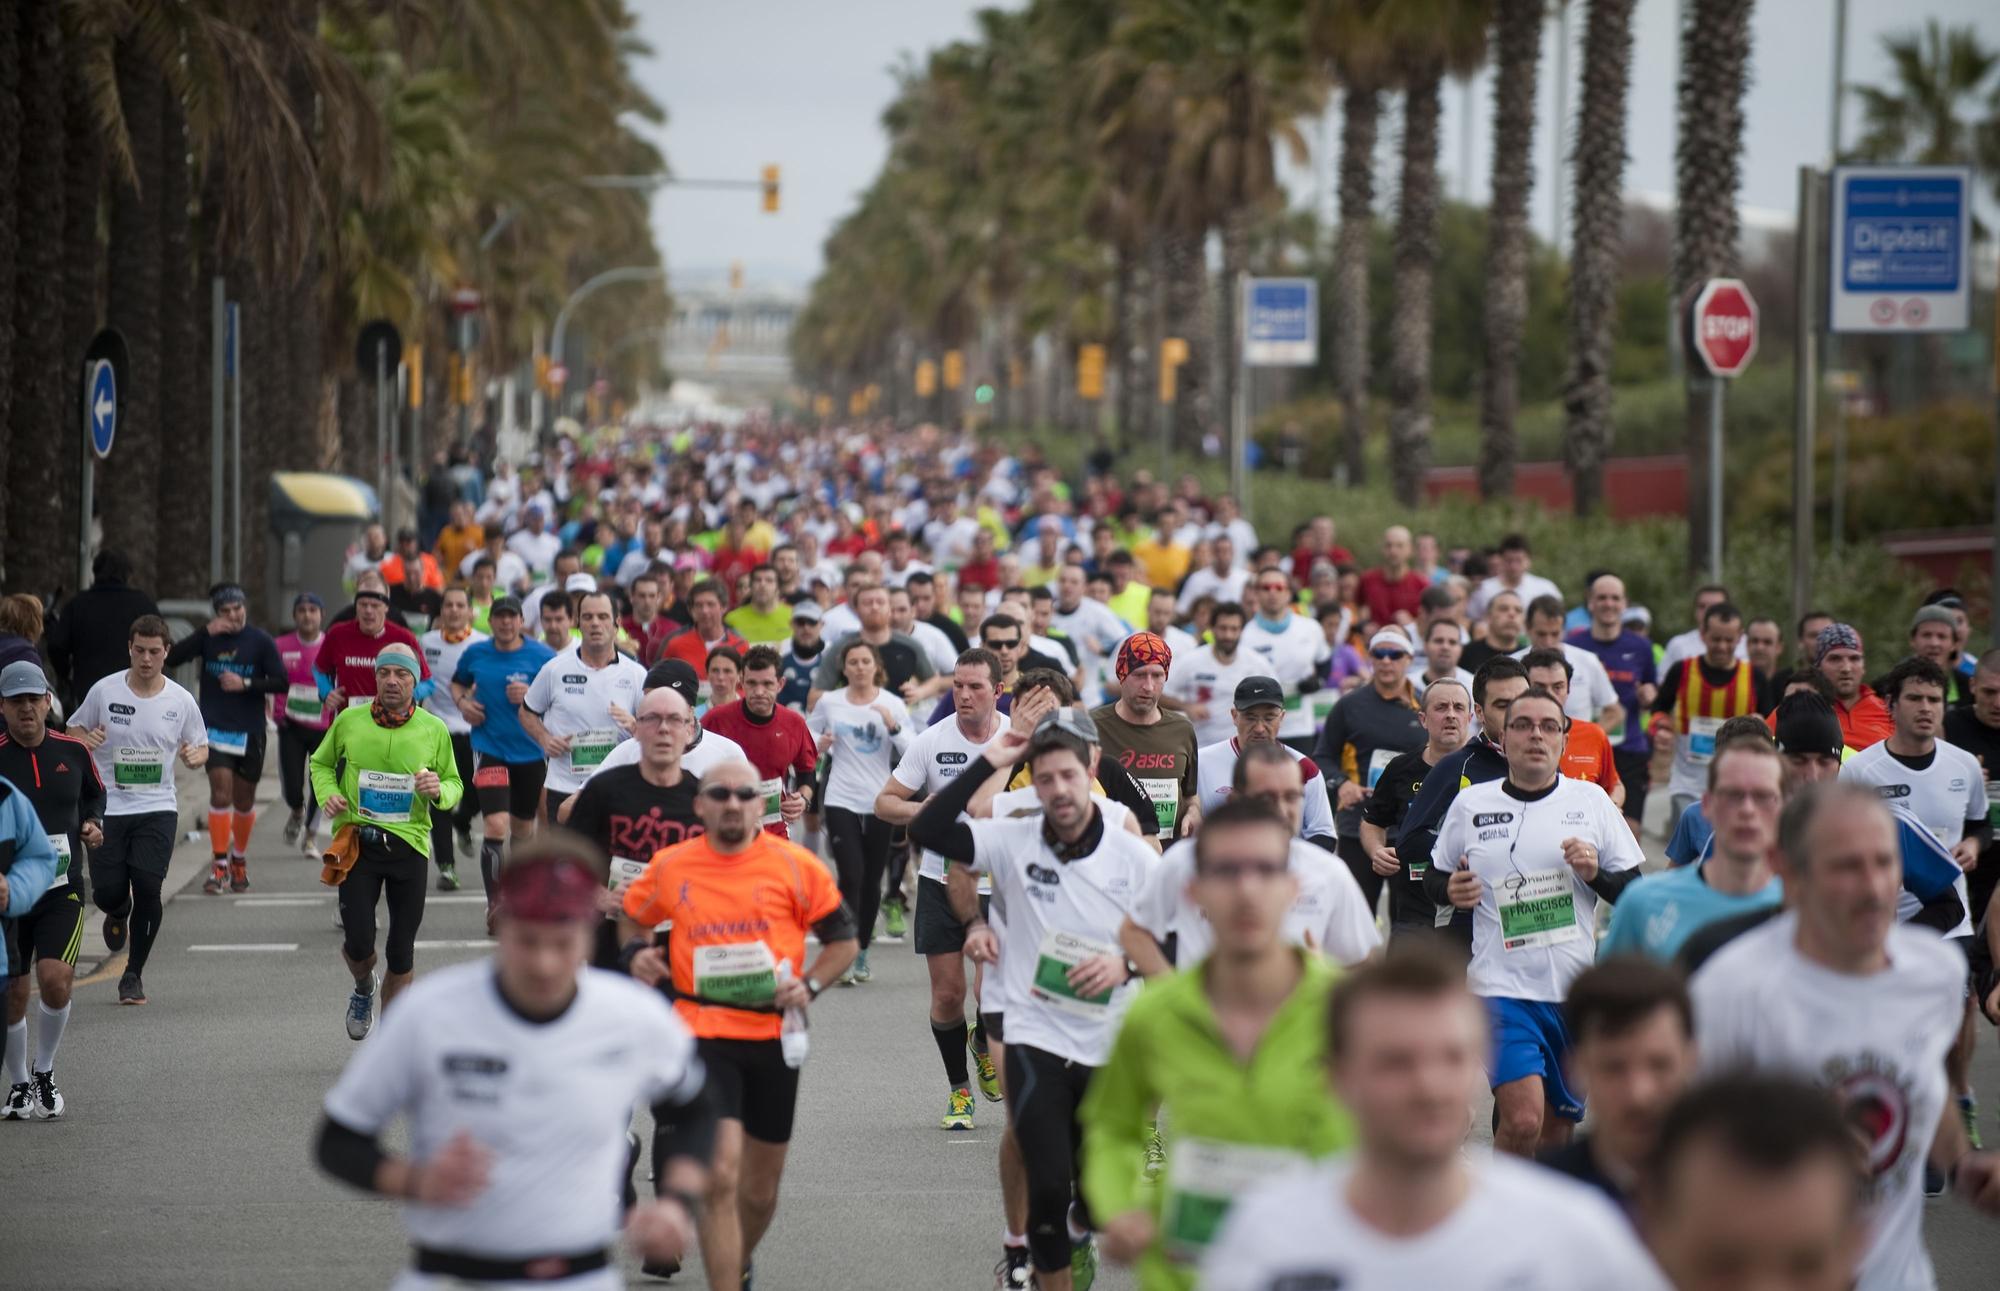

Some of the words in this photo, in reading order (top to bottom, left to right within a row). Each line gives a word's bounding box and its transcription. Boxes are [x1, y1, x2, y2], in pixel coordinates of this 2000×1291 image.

[1703, 315, 1750, 340] STOP
[374, 792, 404, 801] JORDI
[1479, 815, 1495, 825] BCN
[1509, 896, 1573, 918] FRANCISCO
